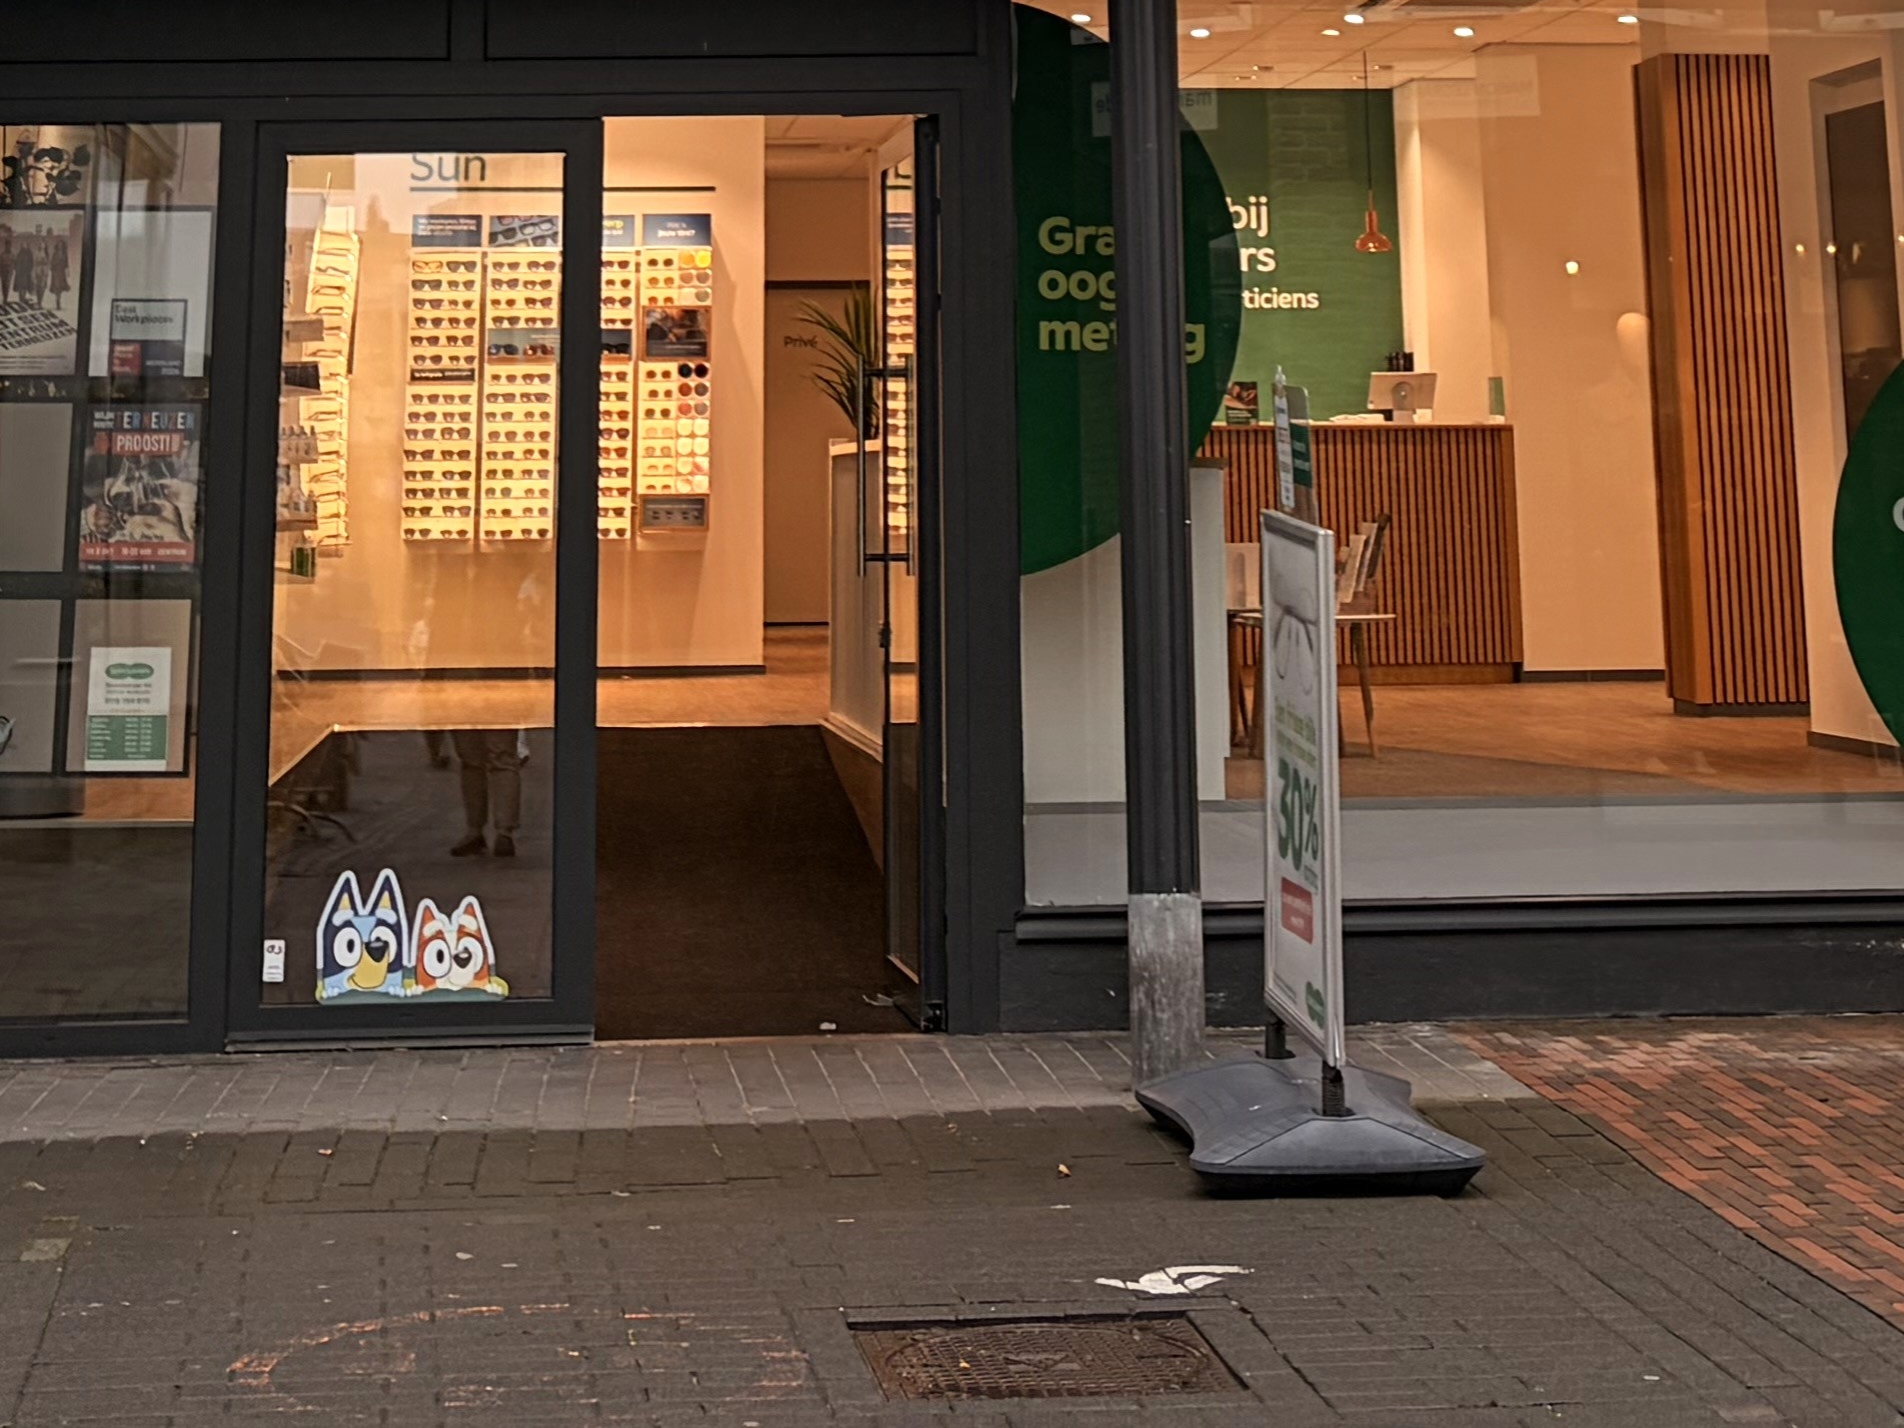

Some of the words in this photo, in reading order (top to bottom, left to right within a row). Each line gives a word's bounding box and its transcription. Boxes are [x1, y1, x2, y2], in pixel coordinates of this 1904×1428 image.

[410, 152, 487, 182] Sun
[1038, 216, 1115, 256] Gra
[1241, 287, 1320, 310] ticiens
[1277, 757, 1319, 872] 30%
